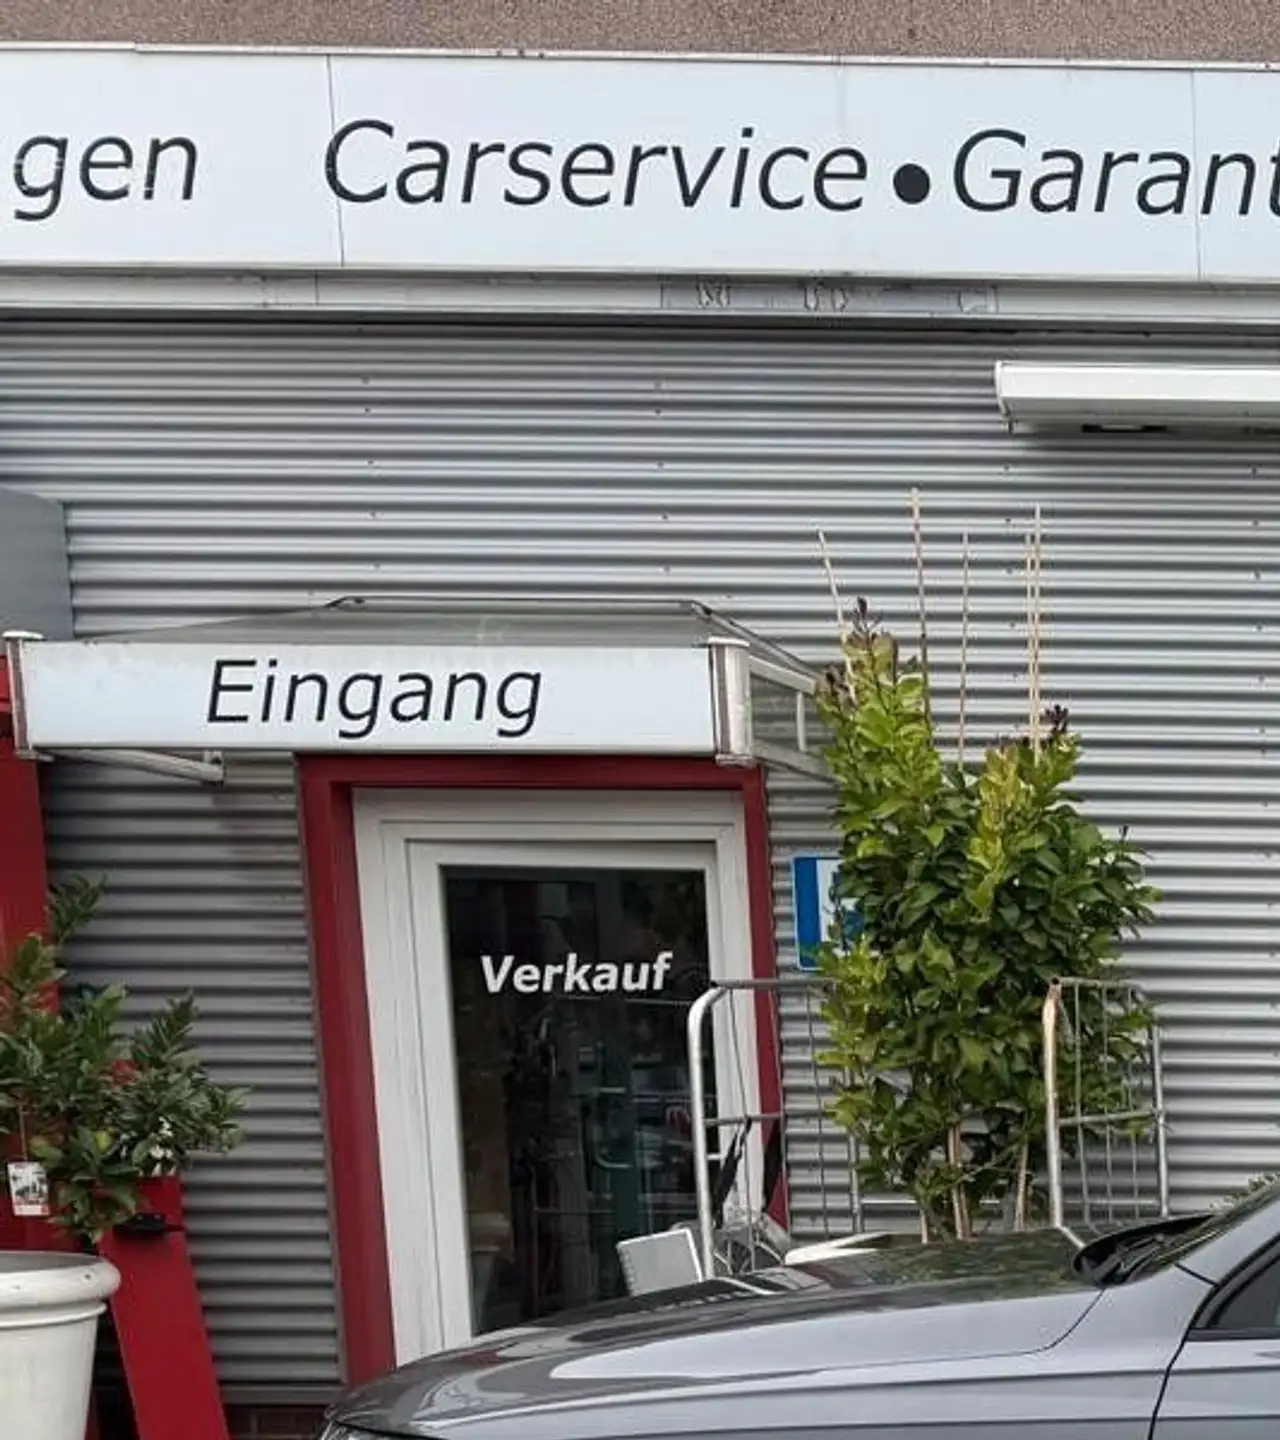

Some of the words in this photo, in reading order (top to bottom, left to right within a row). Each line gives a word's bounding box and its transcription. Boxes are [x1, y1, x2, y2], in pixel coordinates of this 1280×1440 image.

[13, 134, 198, 221] gen
[324, 118, 868, 212] Carservice
[206, 658, 542, 739] Eingang
[481, 950, 674, 993] Verkauf
